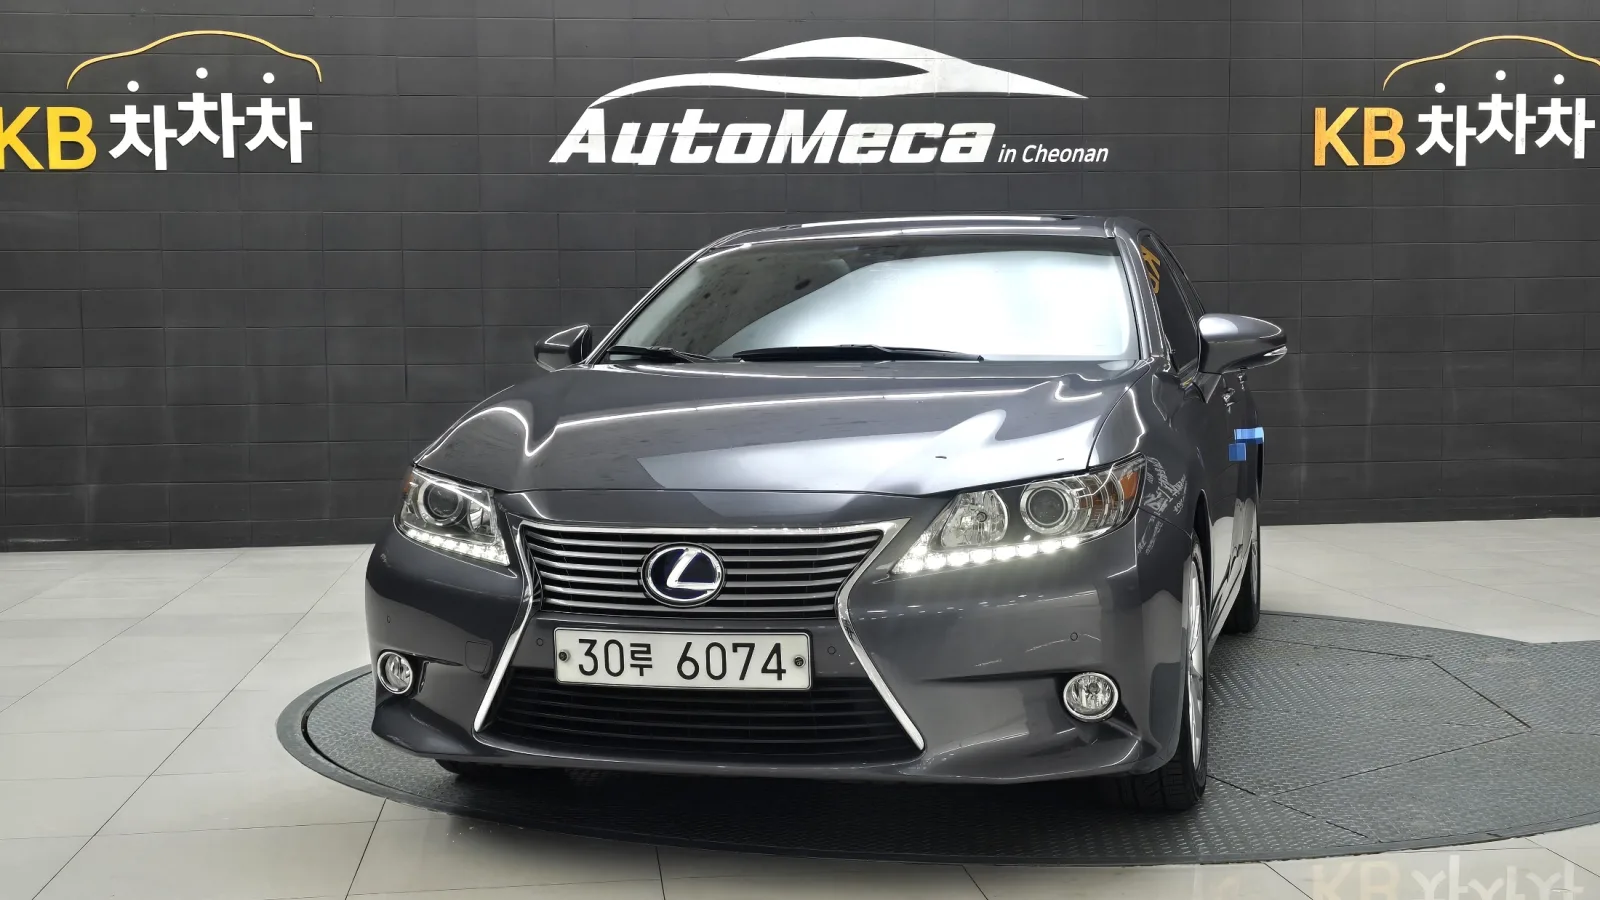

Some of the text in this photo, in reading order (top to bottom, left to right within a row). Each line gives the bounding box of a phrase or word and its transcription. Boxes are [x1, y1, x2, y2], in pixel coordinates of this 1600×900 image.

[0, 106, 97, 170] KB
[108, 92, 313, 171] 차차차
[549, 108, 1109, 166] AutoMeca in Cheonan
[1314, 107, 1406, 167] KB
[1415, 92, 1596, 167] 차차차
[578, 638, 787, 681] 30루 6074
